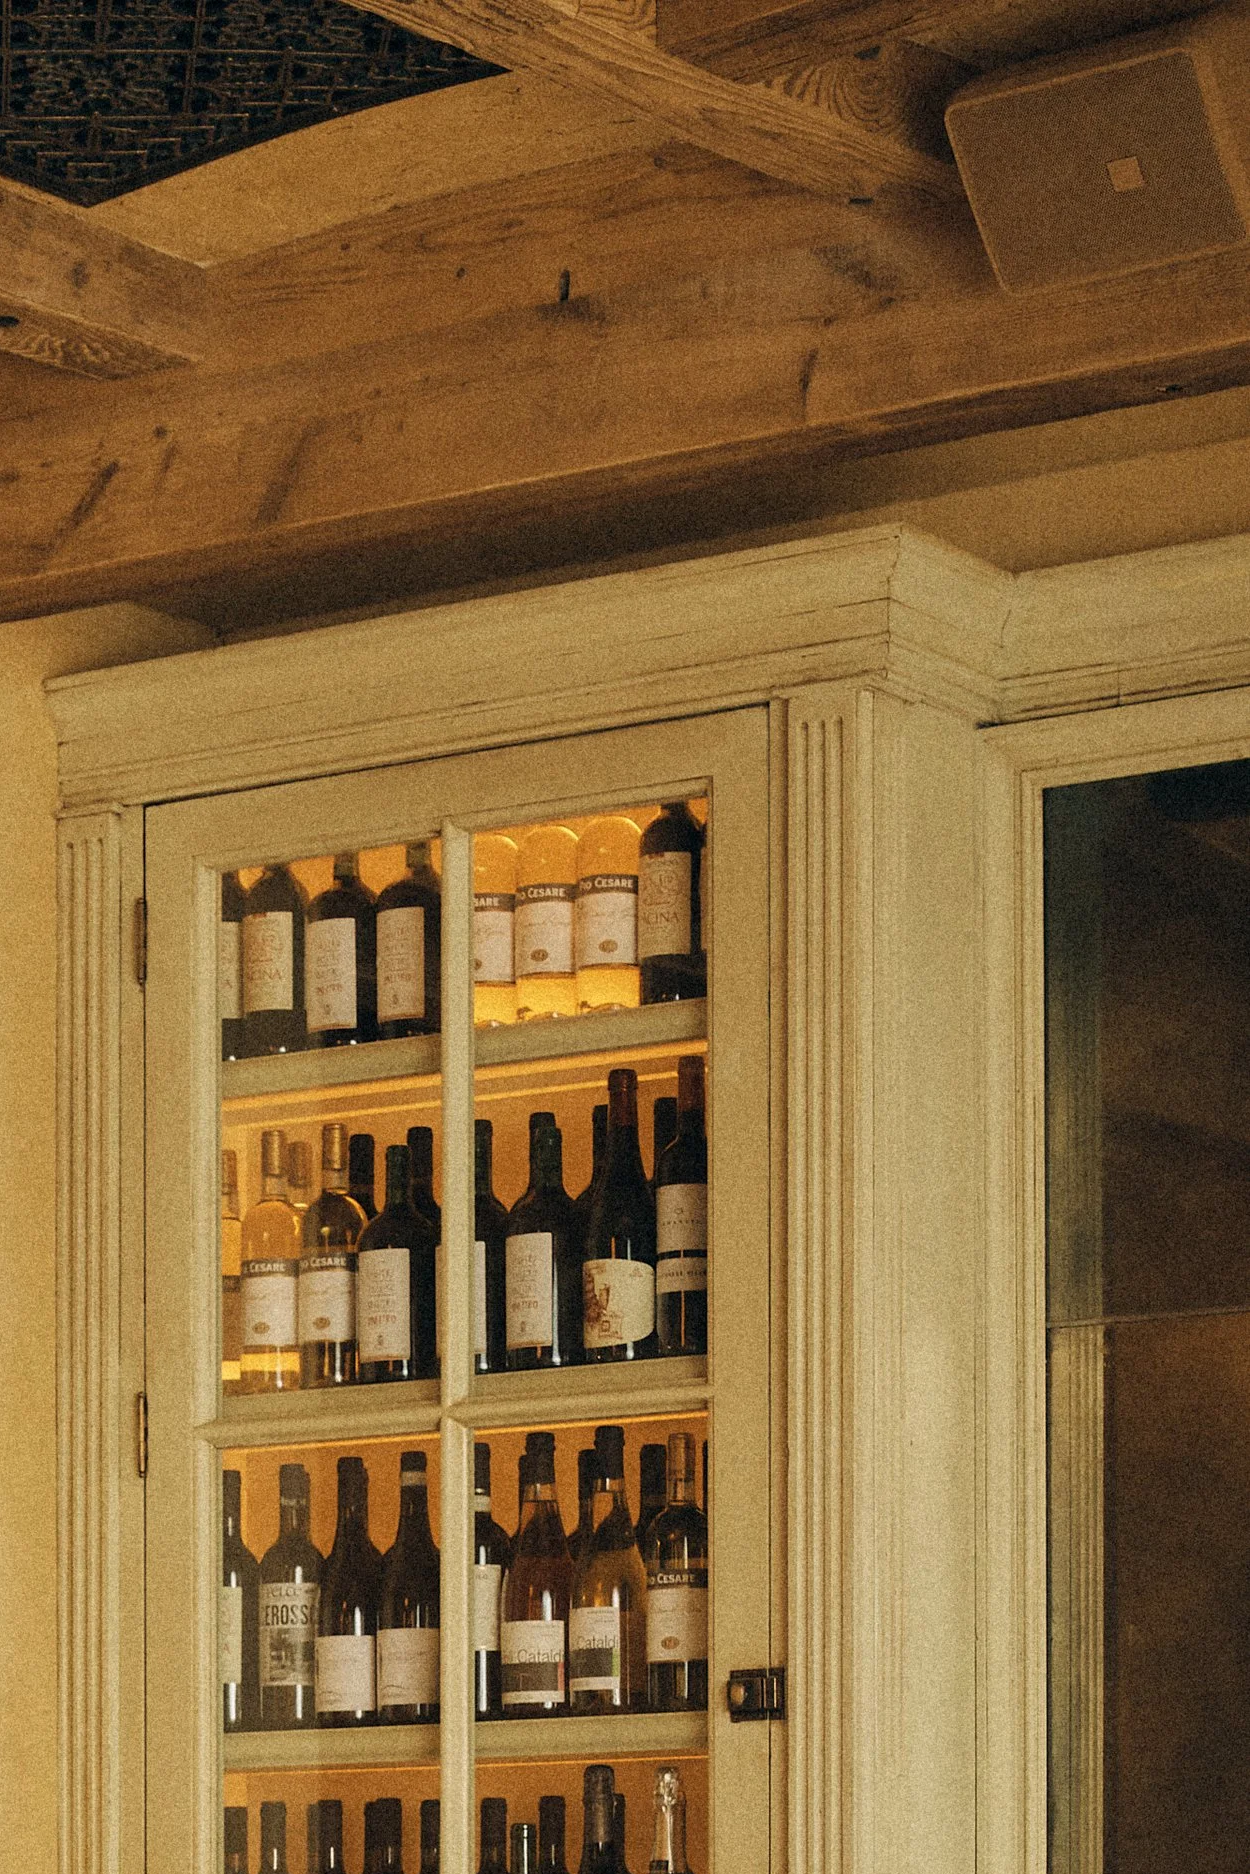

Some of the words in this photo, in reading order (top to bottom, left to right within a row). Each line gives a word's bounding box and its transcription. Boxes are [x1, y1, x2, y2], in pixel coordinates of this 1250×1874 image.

[594, 876, 633, 888] CESARE
[527, 886, 566, 898] CESARE
[249, 1261, 286, 1273] CESARE
[310, 1256, 346, 1267] CESARE
[656, 1572, 696, 1584] CESARE
